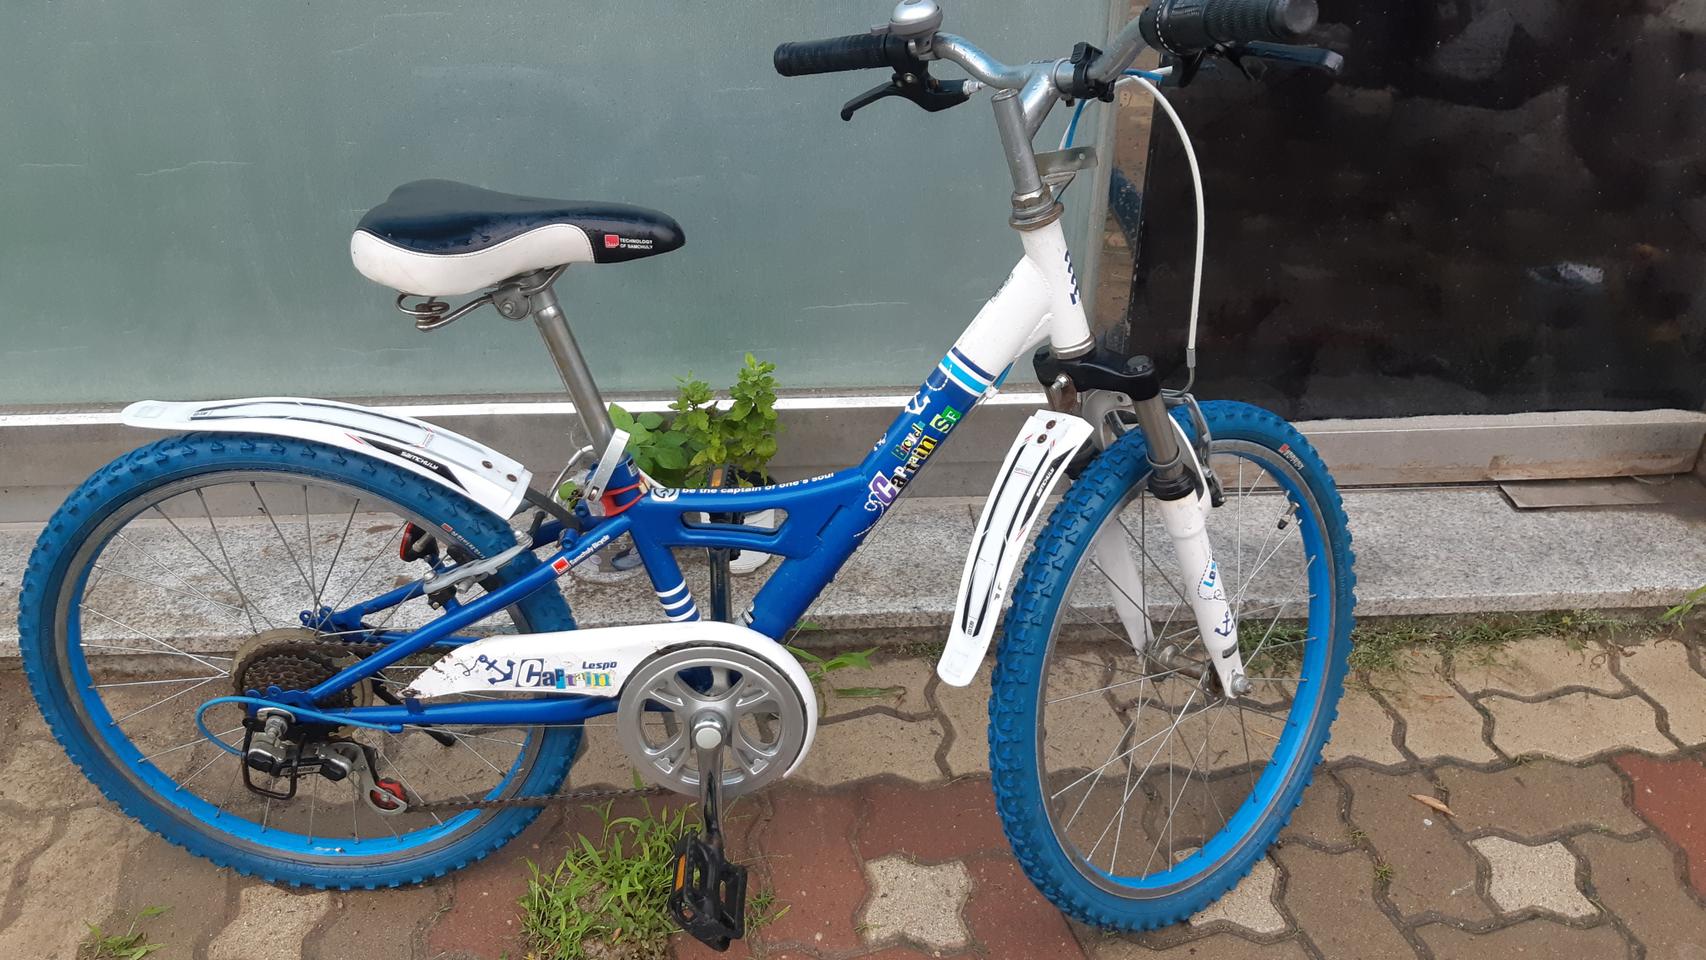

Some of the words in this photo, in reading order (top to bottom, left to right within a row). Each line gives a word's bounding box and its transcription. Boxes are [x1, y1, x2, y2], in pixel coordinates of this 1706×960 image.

[720, 486, 762, 495] captain
[811, 472, 835, 482] soul
[582, 660, 618, 670] Lespo
